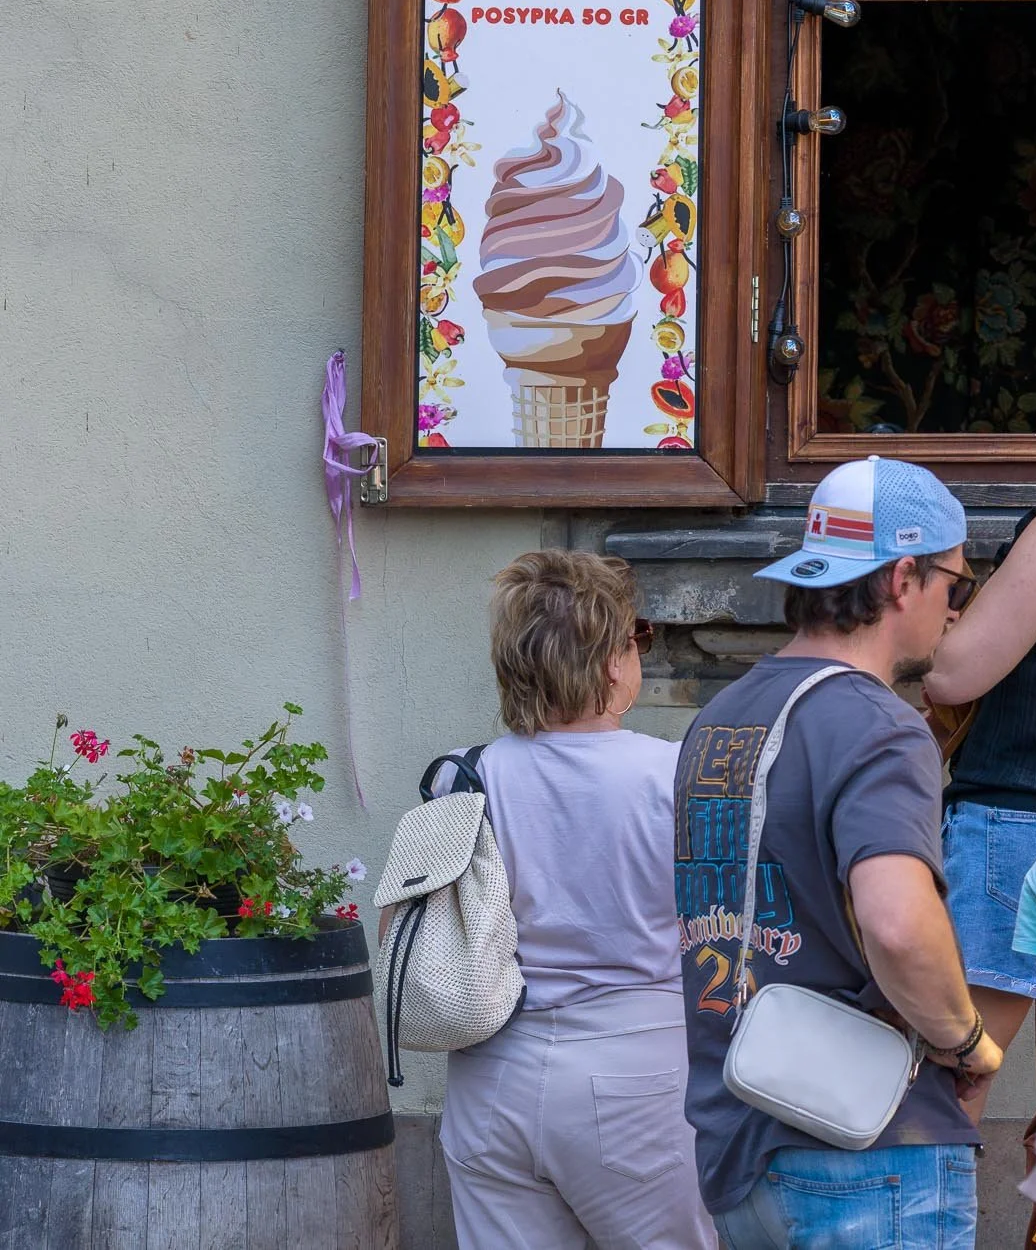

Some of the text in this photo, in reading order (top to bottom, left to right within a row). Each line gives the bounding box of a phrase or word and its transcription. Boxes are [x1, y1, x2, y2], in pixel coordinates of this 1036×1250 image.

[472, 8, 648, 25] POSYPKA 50 GR
